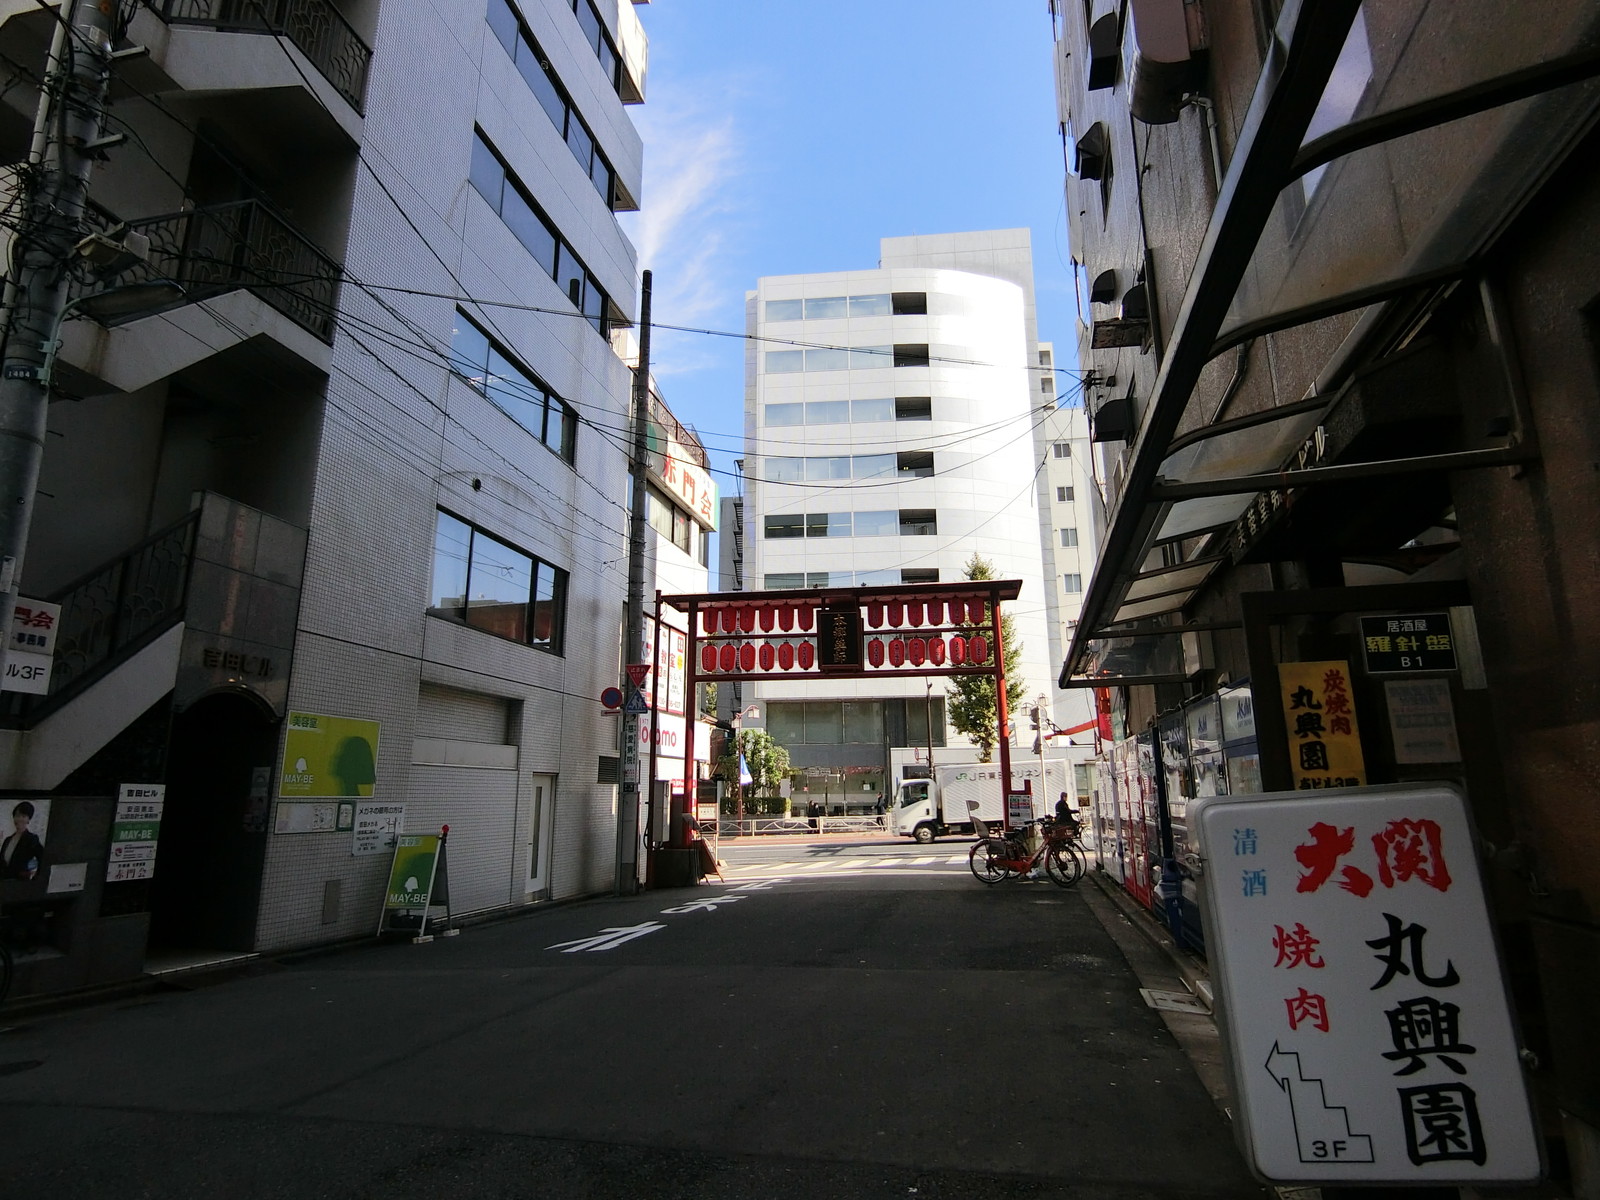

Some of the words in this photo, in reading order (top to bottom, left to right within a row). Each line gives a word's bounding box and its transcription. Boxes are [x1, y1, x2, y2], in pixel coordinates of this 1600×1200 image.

[663, 453, 712, 520] 赤門会
[1365, 634, 1452, 653] 羅針盤
[1387, 619, 1428, 633] 居酒屋
[292, 715, 318, 730] 美容室
[1322, 668, 1351, 736] 炭焼肉
[1290, 685, 1329, 771] 丸興園
[284, 773, 314, 784] MAY-BE
[119, 829, 152, 840] MAY-BE
[1232, 827, 1267, 897] 清酒
[1294, 817, 1453, 898] 大関
[389, 893, 427, 903] MAY-BE
[1272, 922, 1331, 1034] 焼肉
[1365, 912, 1488, 1167] 丸興園
[1312, 1140, 1347, 1158] 3F
